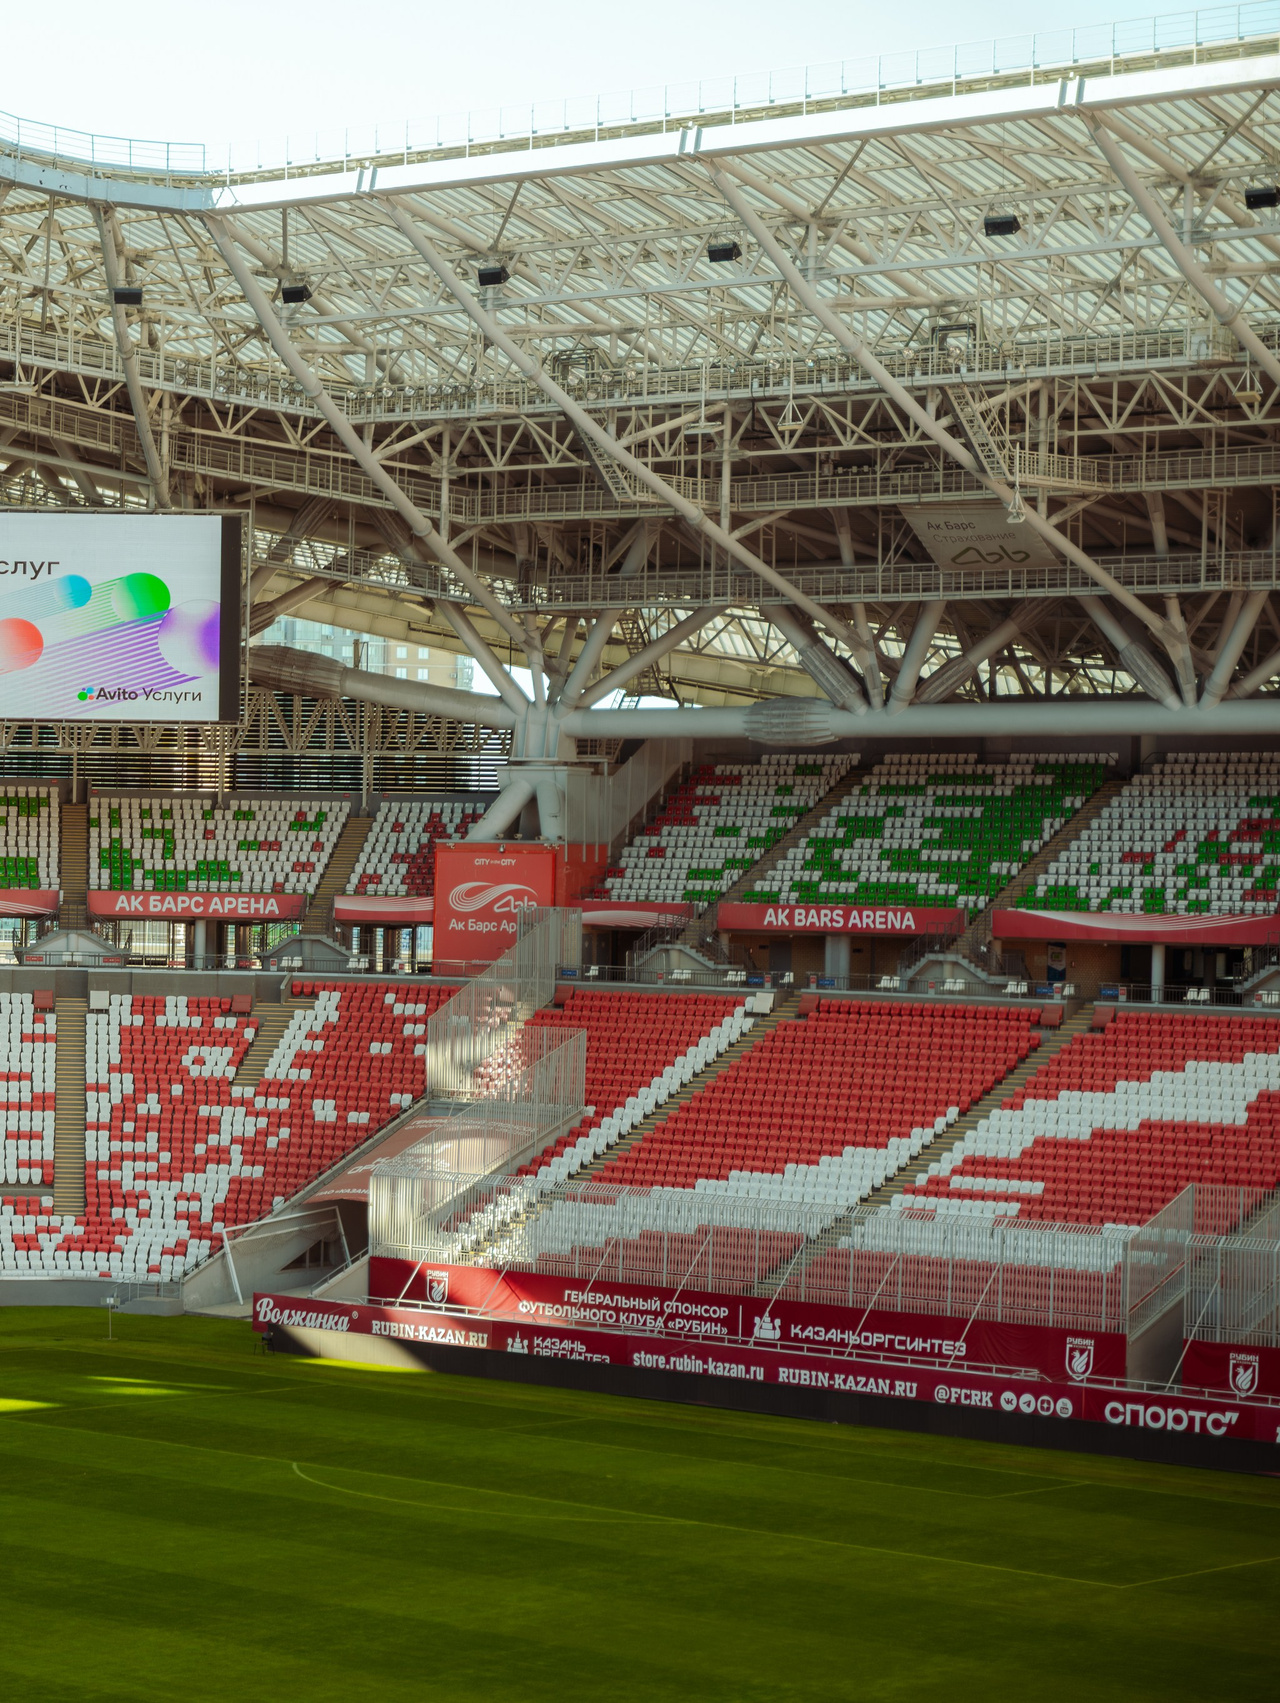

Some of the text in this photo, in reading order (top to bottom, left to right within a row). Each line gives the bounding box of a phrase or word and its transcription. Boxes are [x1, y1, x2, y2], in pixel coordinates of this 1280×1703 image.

[927, 521, 976, 531] Ак Барс
[933, 531, 1016, 544] Страхование
[96, 687, 202, 704] Avito Услуги
[115, 895, 279, 914] АК БАРС АРЕНА
[449, 919, 465, 930] Ак
[468, 919, 497, 934] Барс
[764, 908, 916, 930] AK BARS ARENA
[564, 1290, 729, 1319] ГЕНЕРАЛЬНЫЙ СПОНСОР
[519, 1300, 728, 1335] ФУТБОЛЬНОГО КЛУБА «РУБИН»
[372, 1320, 488, 1348] RUBIN-KAZAN.RU
[534, 1336, 586, 1352] КАЗАНЬ
[791, 1324, 966, 1356] КАЗАНЬОРГСИНТЕЗ
[1066, 1337, 1094, 1346] РУБИН
[633, 1351, 764, 1380] store.rubin-kazan.ru
[1229, 1352, 1259, 1362] РУБИН
[778, 1367, 918, 1398] RUBIN-KAZAN.RU
[934, 1385, 993, 1407] @FCRK
